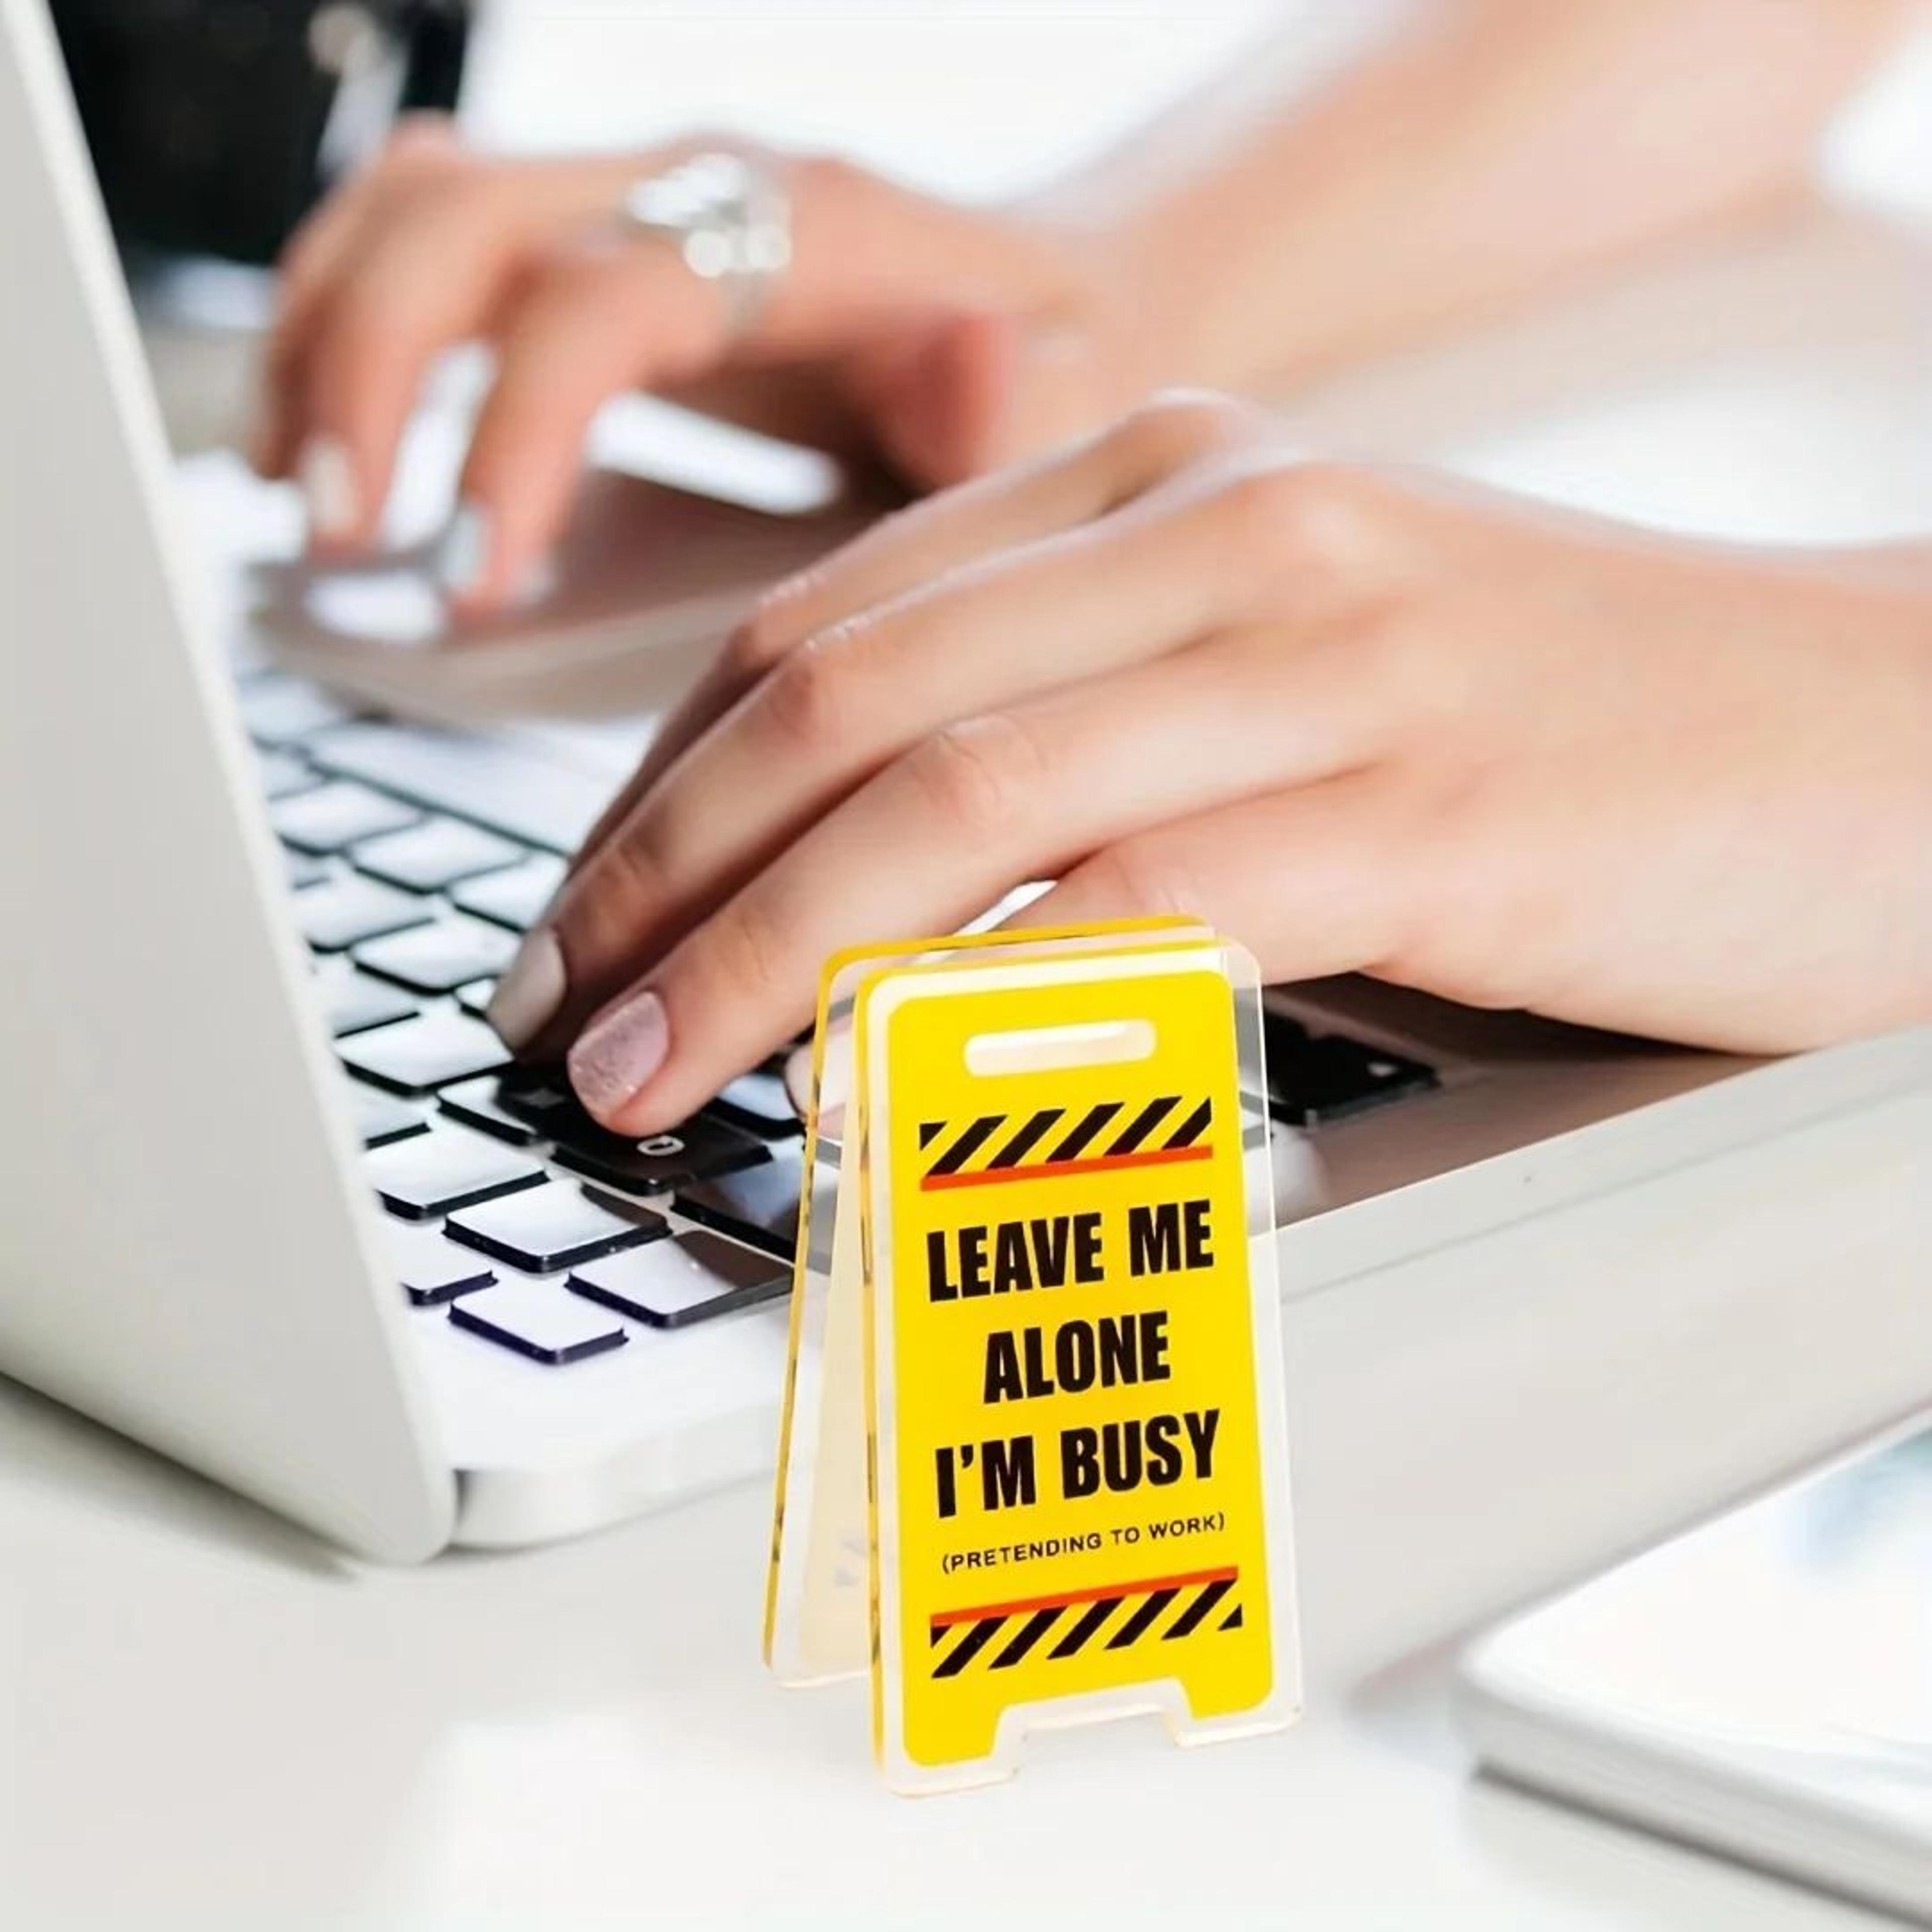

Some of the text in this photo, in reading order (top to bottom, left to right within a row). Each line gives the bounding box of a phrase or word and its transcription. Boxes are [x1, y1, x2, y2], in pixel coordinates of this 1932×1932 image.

[927, 1199, 1214, 1302] LEAVE ME
[984, 1310, 1171, 1404] ALONE
[935, 1409, 1220, 1518] I'M BUSY
[942, 1512, 1225, 1574] (PRETENDING TO WORK)
